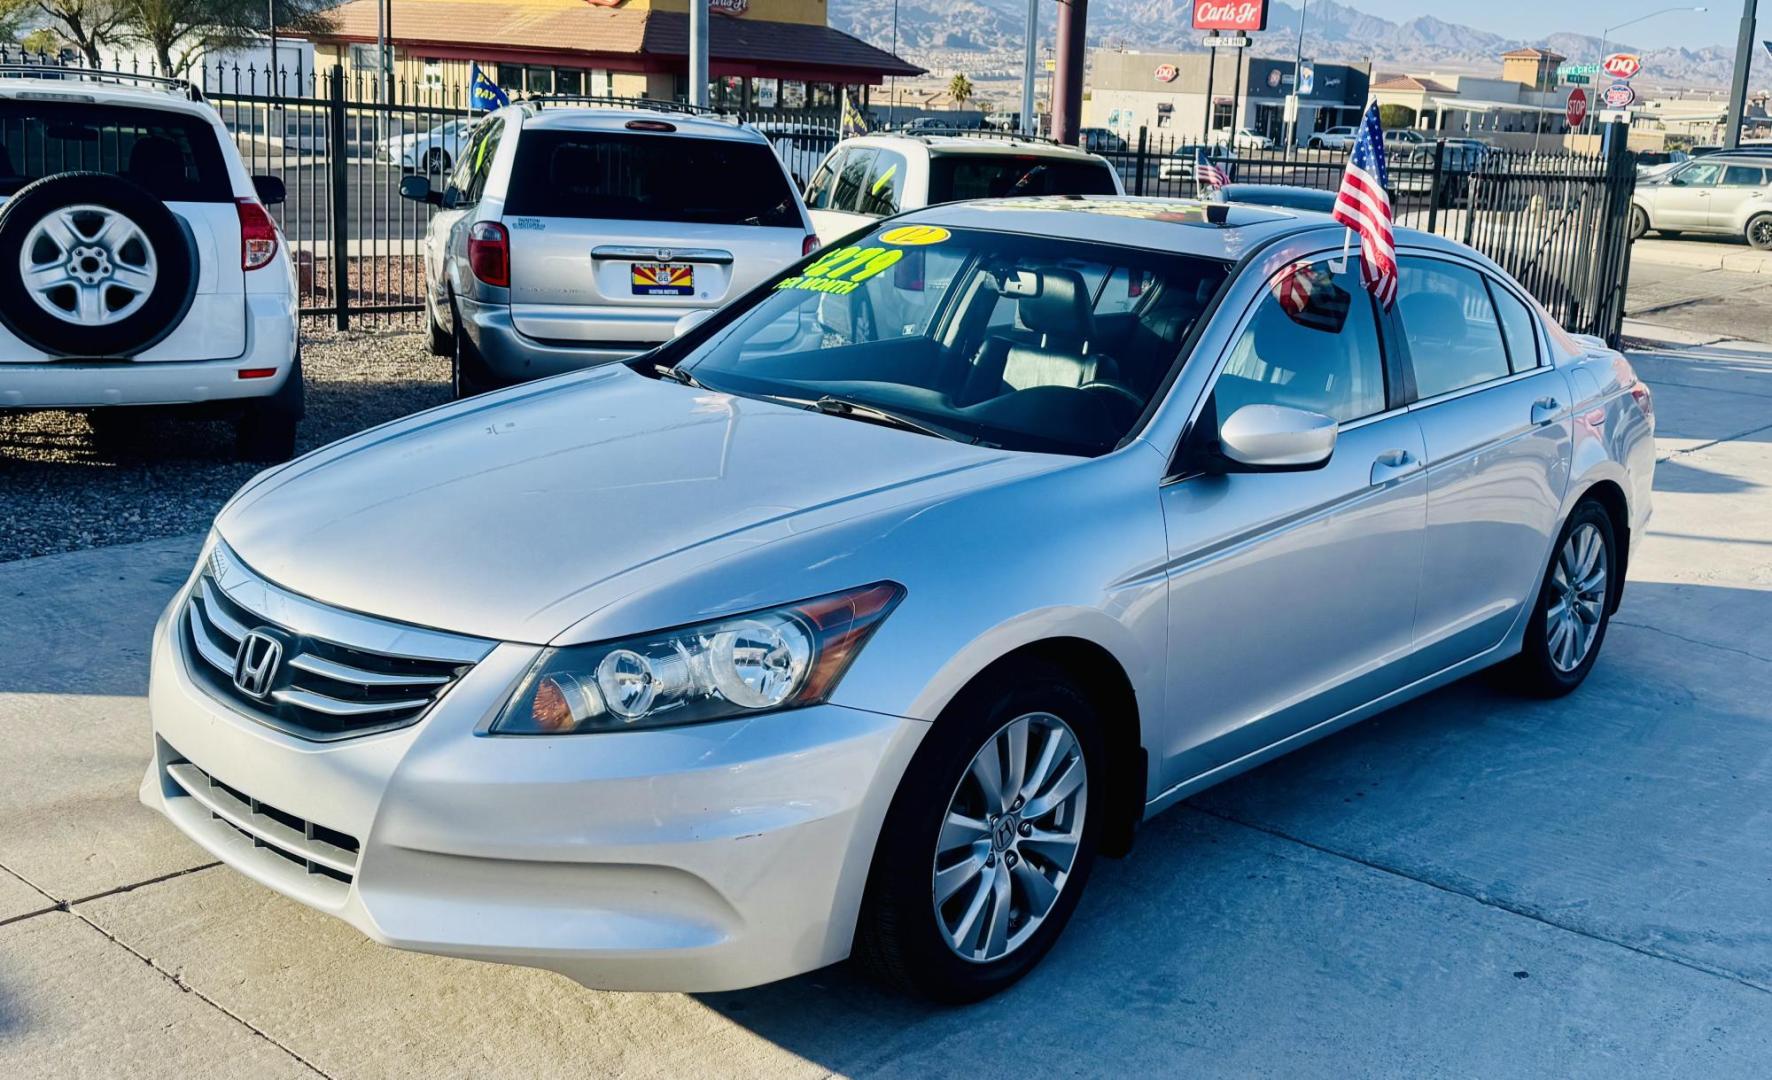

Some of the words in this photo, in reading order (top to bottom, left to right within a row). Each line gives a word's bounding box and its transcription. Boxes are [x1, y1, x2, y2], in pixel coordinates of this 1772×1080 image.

[1197, 2, 1236, 22] Carl's
[1608, 58, 1635, 74] DQ
[1568, 99, 1586, 115] STOP
